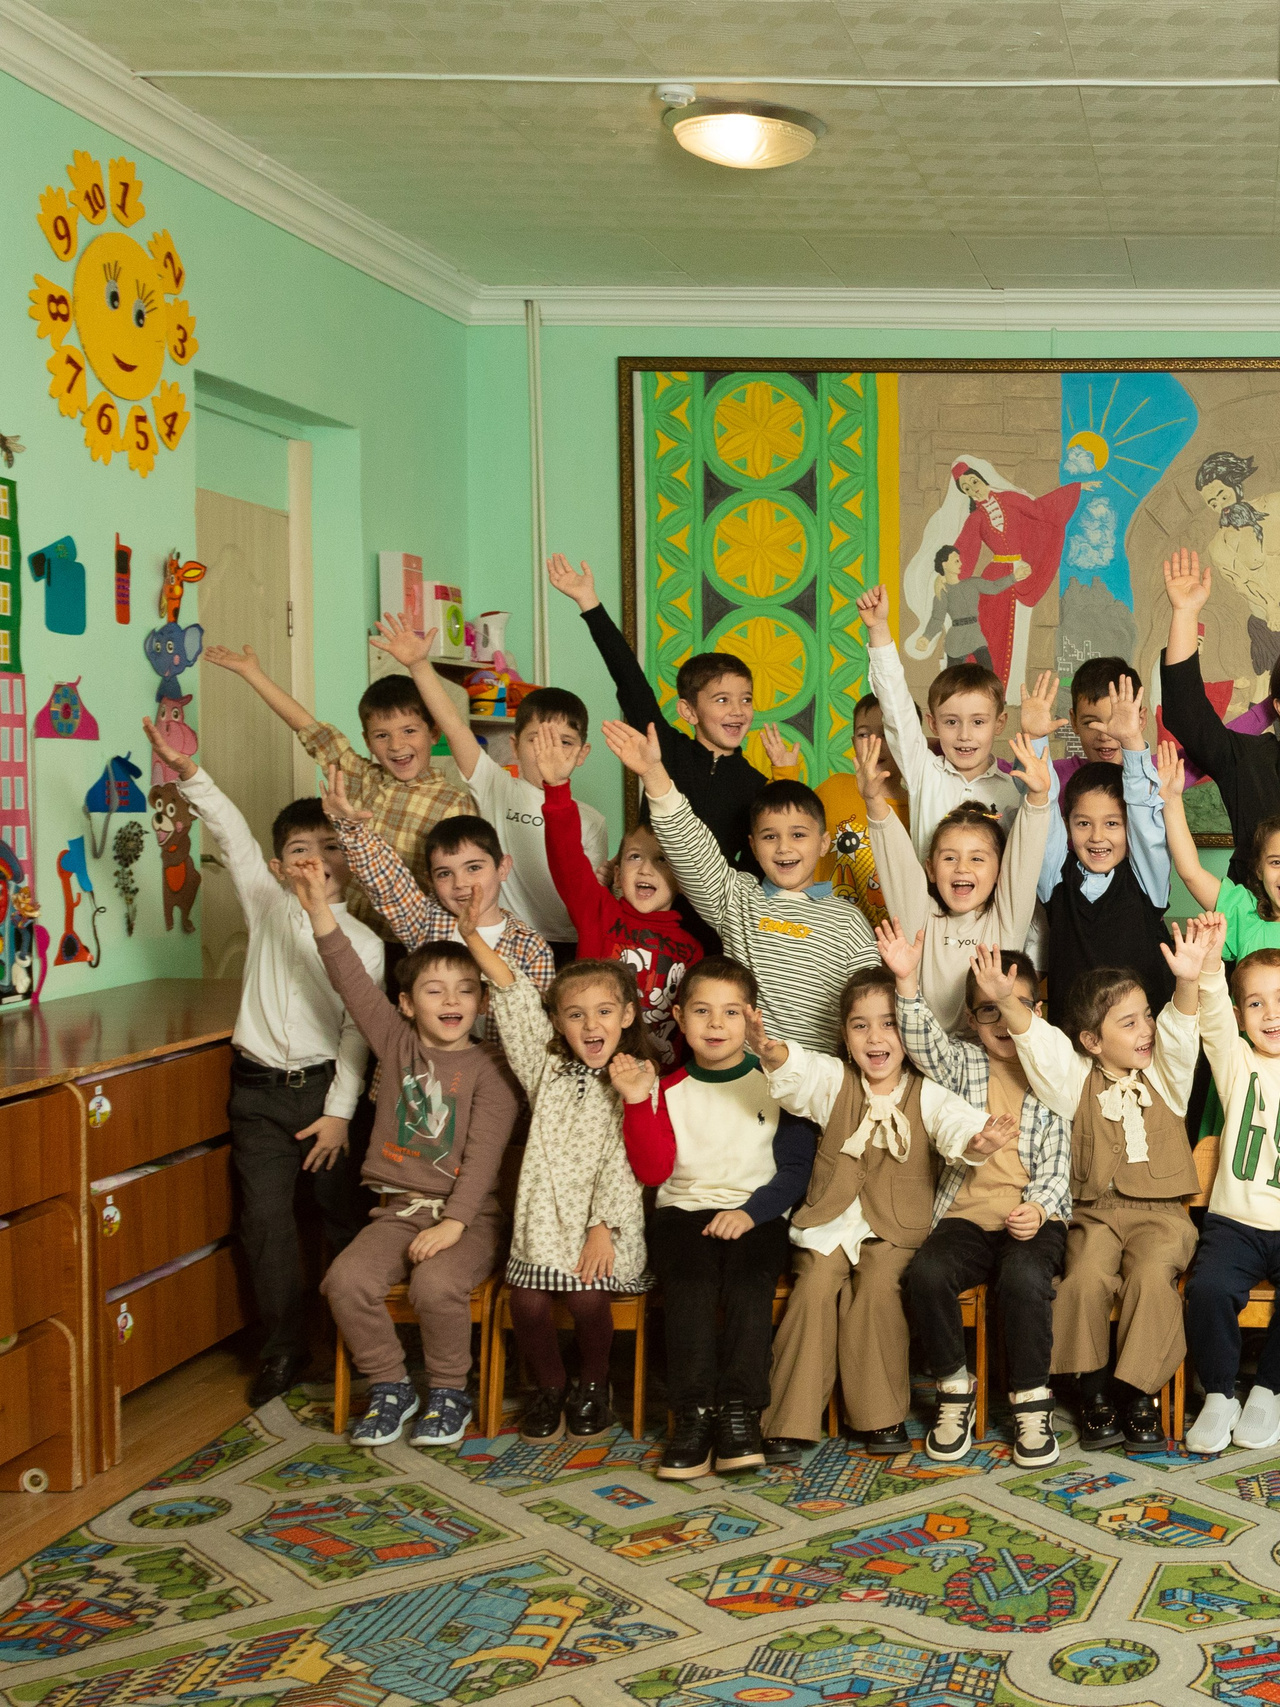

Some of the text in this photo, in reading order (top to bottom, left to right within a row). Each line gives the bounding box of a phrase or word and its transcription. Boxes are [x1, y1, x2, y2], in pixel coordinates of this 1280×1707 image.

[83, 183, 106, 219] 10
[116, 182, 130, 218] 1
[53, 215, 71, 254] 9
[163, 252, 183, 288] 2
[47, 294, 69, 322] 8
[173, 324, 188, 358] 3
[65, 354, 83, 393] 7
[96, 402, 115, 435] 6
[134, 415, 150, 451] 5
[162, 411, 179, 441] 4
[506, 808, 544, 827] LACO
[608, 918, 698, 963] MICKEY
[957, 938, 979, 948] you
